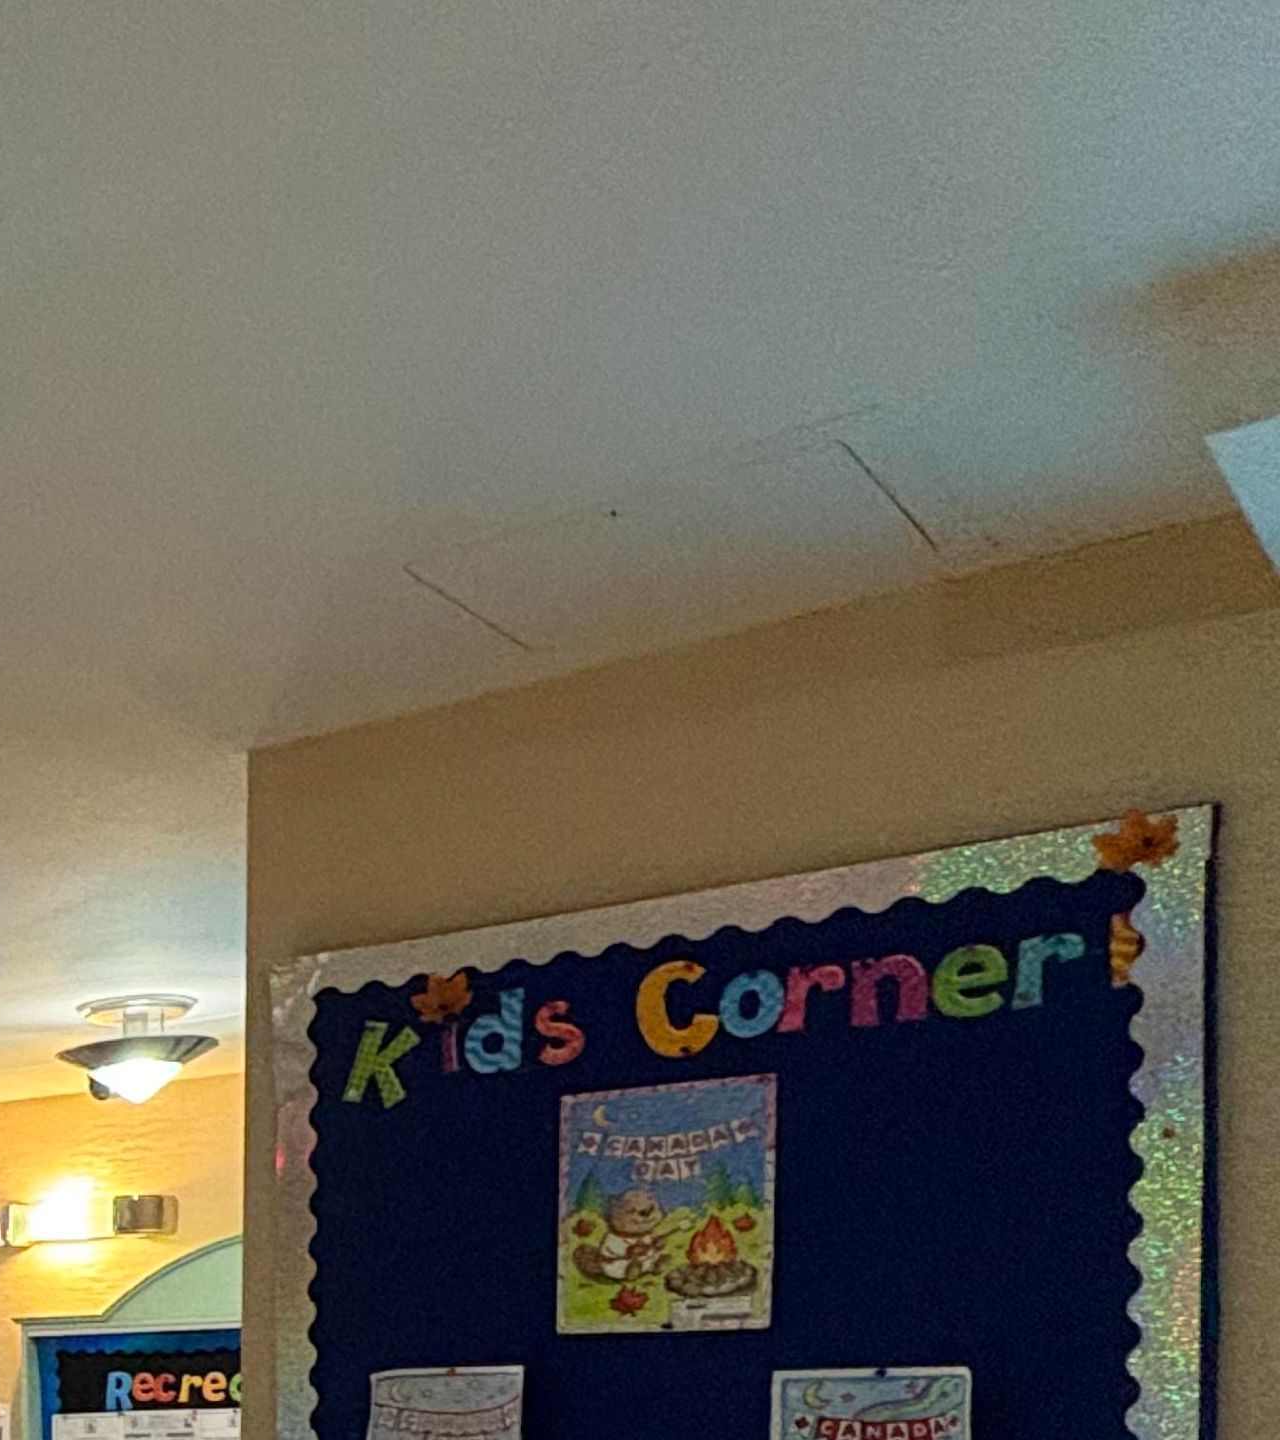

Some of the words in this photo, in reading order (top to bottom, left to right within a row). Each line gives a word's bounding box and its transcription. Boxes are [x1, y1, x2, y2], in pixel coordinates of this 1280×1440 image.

[342, 987, 586, 1109] Kids
[636, 932, 1086, 1058] Corner
[607, 1128, 729, 1152] CANADA
[633, 1159, 701, 1177] DAY
[818, 1417, 947, 1440] CANADA
